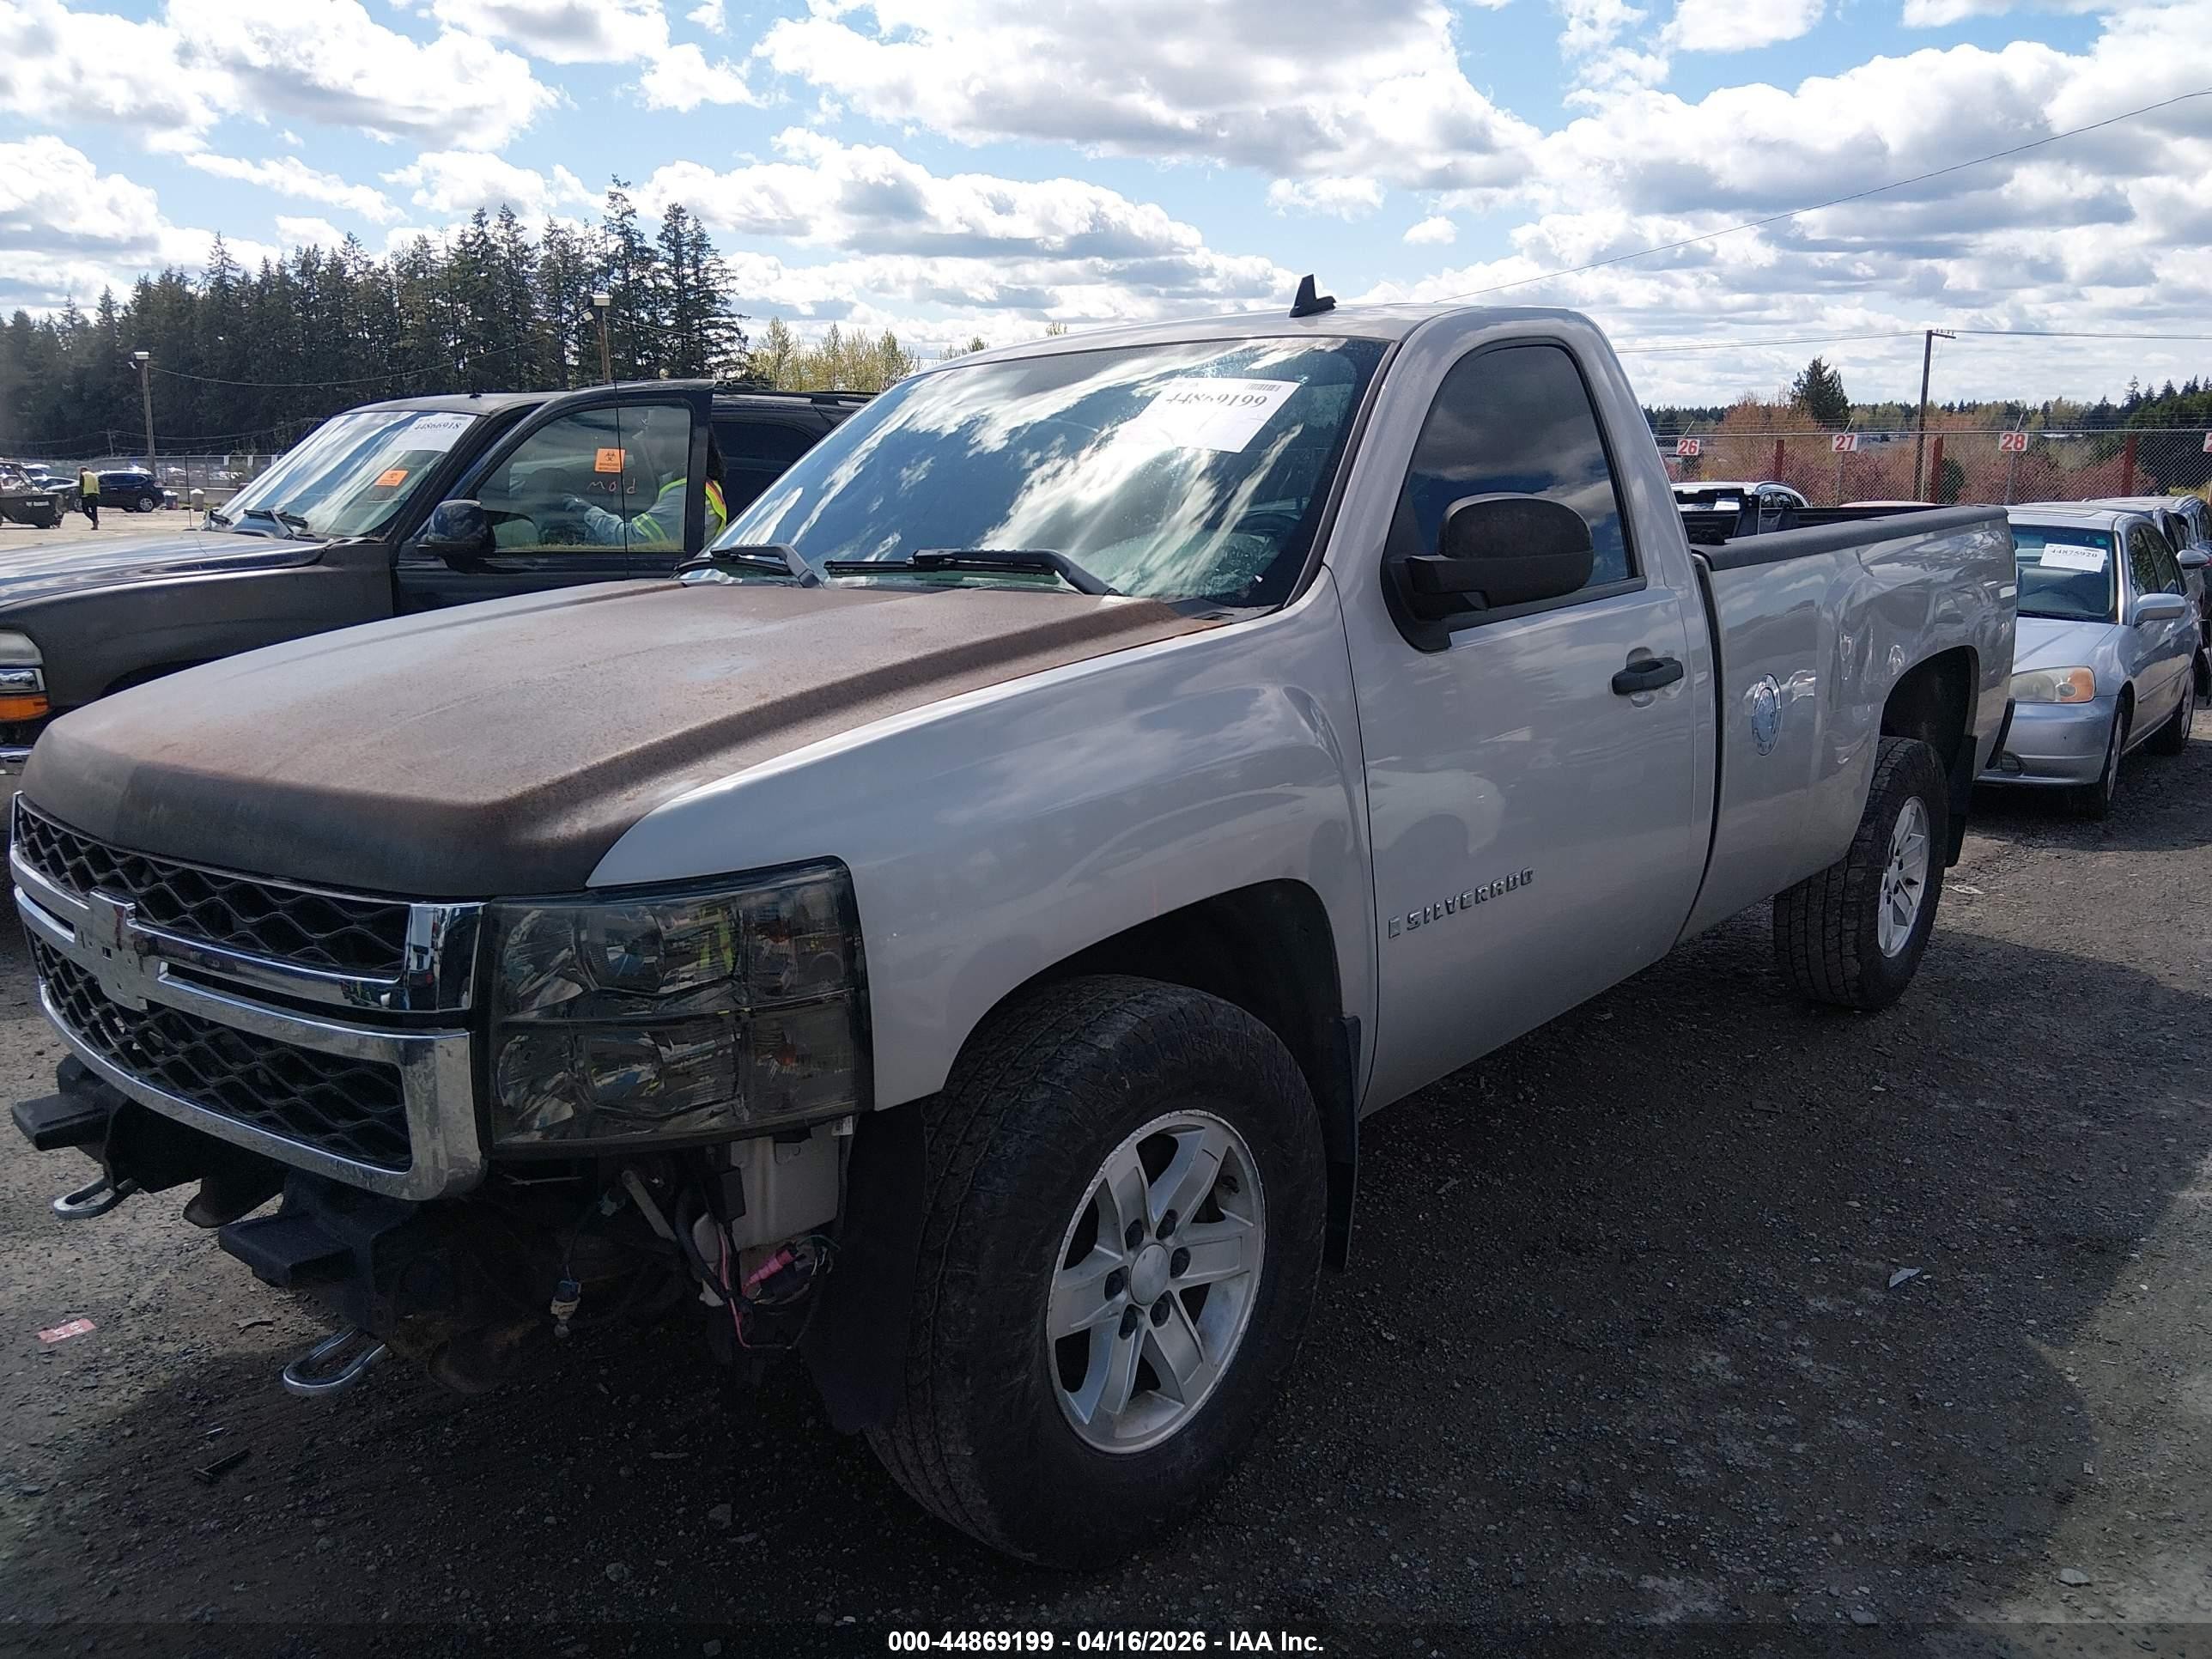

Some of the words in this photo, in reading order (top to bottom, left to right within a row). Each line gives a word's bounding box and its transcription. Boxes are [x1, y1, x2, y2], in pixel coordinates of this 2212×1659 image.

[1678, 439, 1698, 454] 26
[1835, 434, 1856, 451] 27
[2001, 433, 2027, 451] 28
[1407, 867, 1534, 931] SILVERADO
